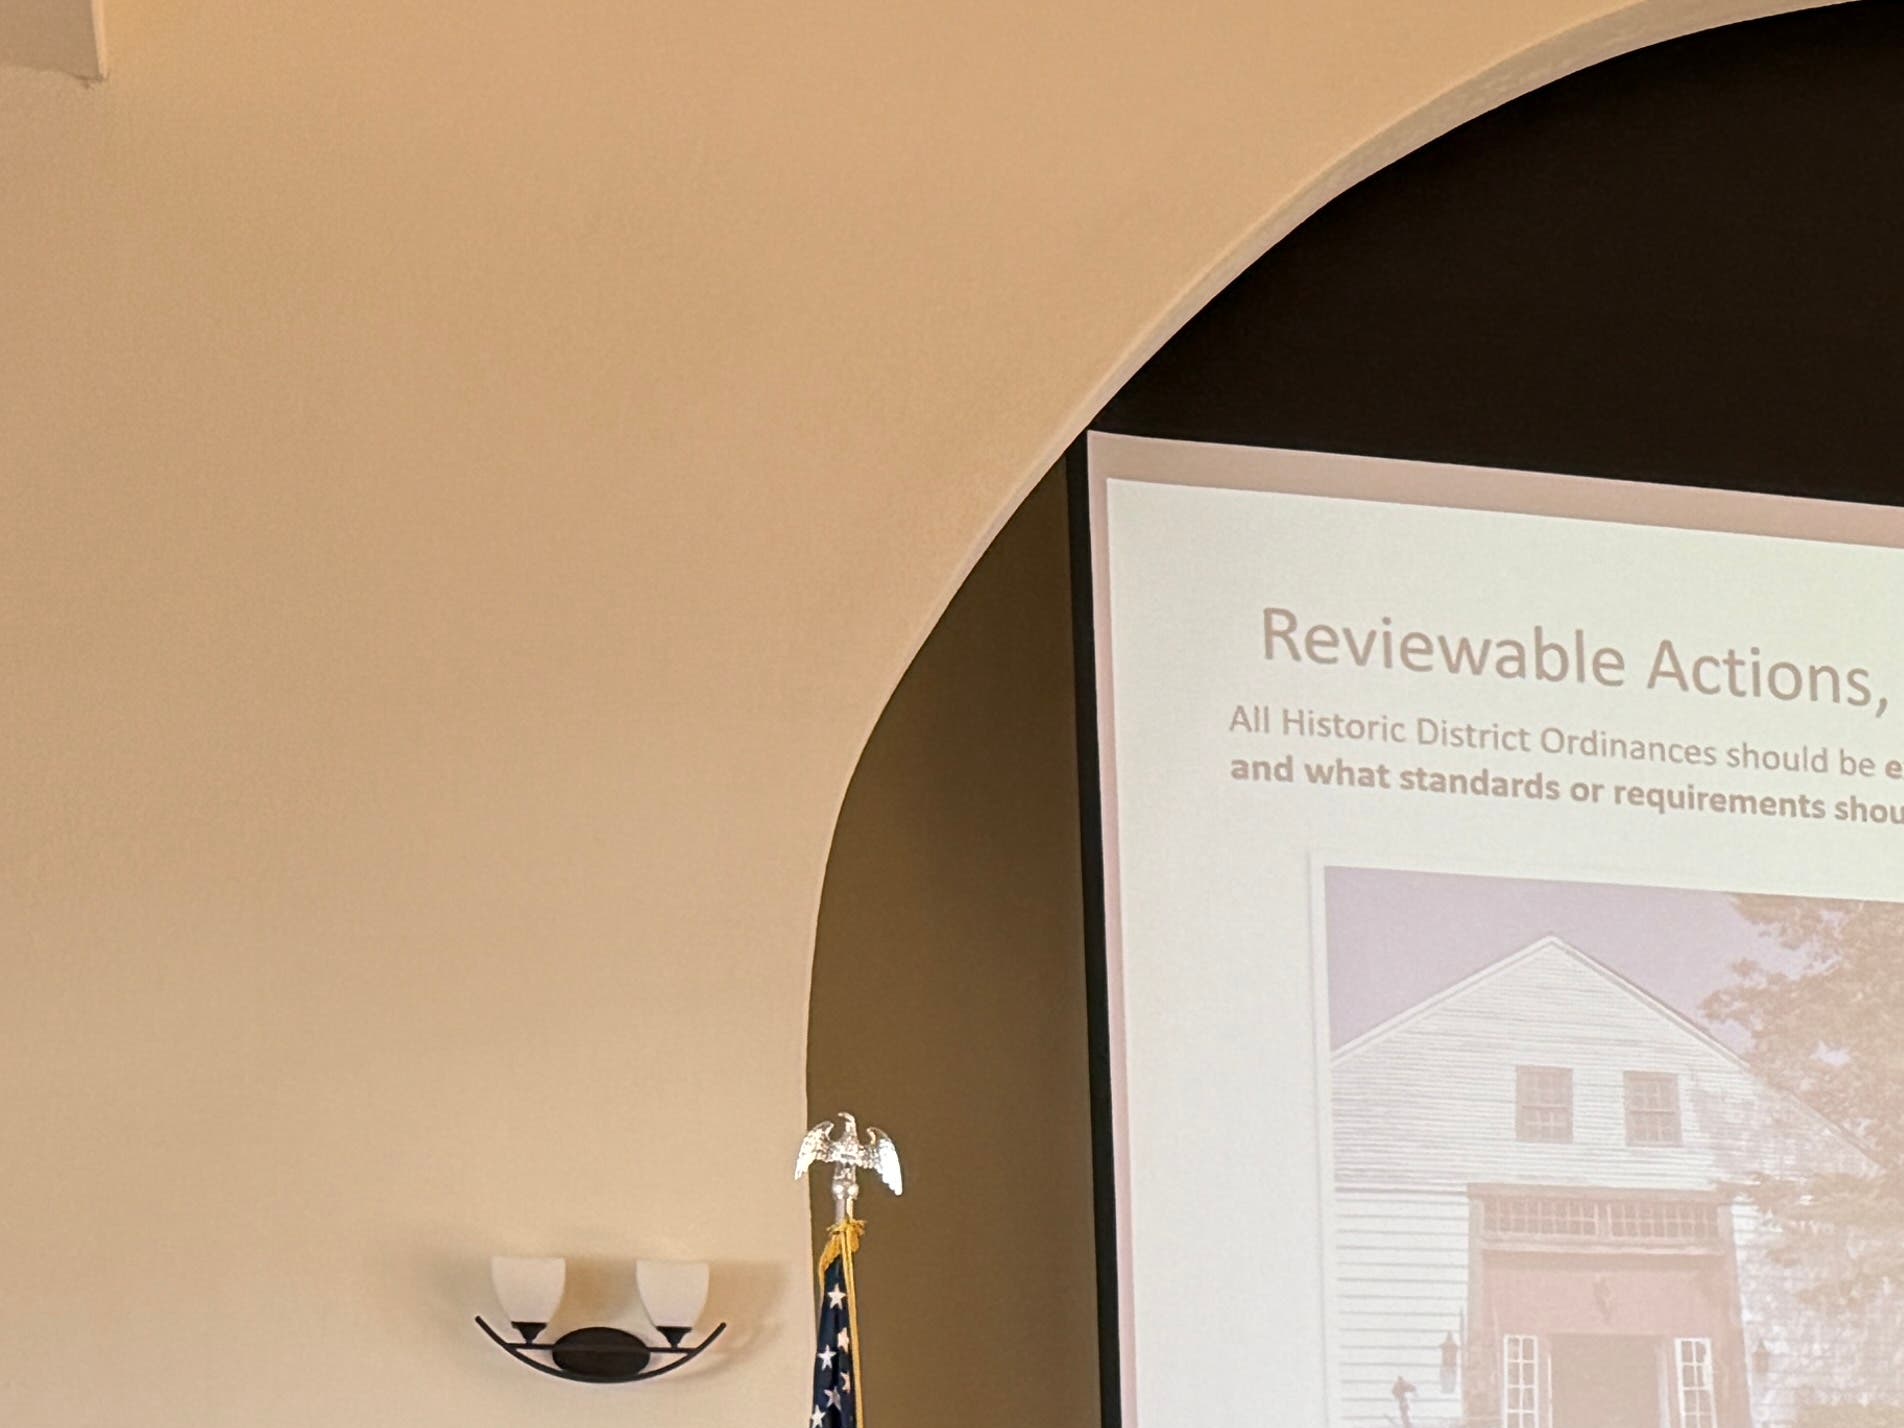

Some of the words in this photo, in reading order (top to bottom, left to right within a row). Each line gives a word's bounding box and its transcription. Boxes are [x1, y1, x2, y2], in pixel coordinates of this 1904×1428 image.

[1262, 606, 1626, 688] Reviewable
[1645, 638, 1889, 720] Actions,
[1228, 704, 1271, 735] All
[1281, 707, 1407, 744] Historic
[1416, 716, 1532, 754] District
[1539, 726, 1718, 768] Ordinances
[1725, 740, 1830, 774] should
[1838, 747, 1877, 779] be
[1229, 753, 1295, 784] and
[1303, 756, 1392, 790] what
[1398, 766, 1562, 802] standards
[1568, 781, 1606, 805] or
[1613, 782, 1827, 820] requirements
